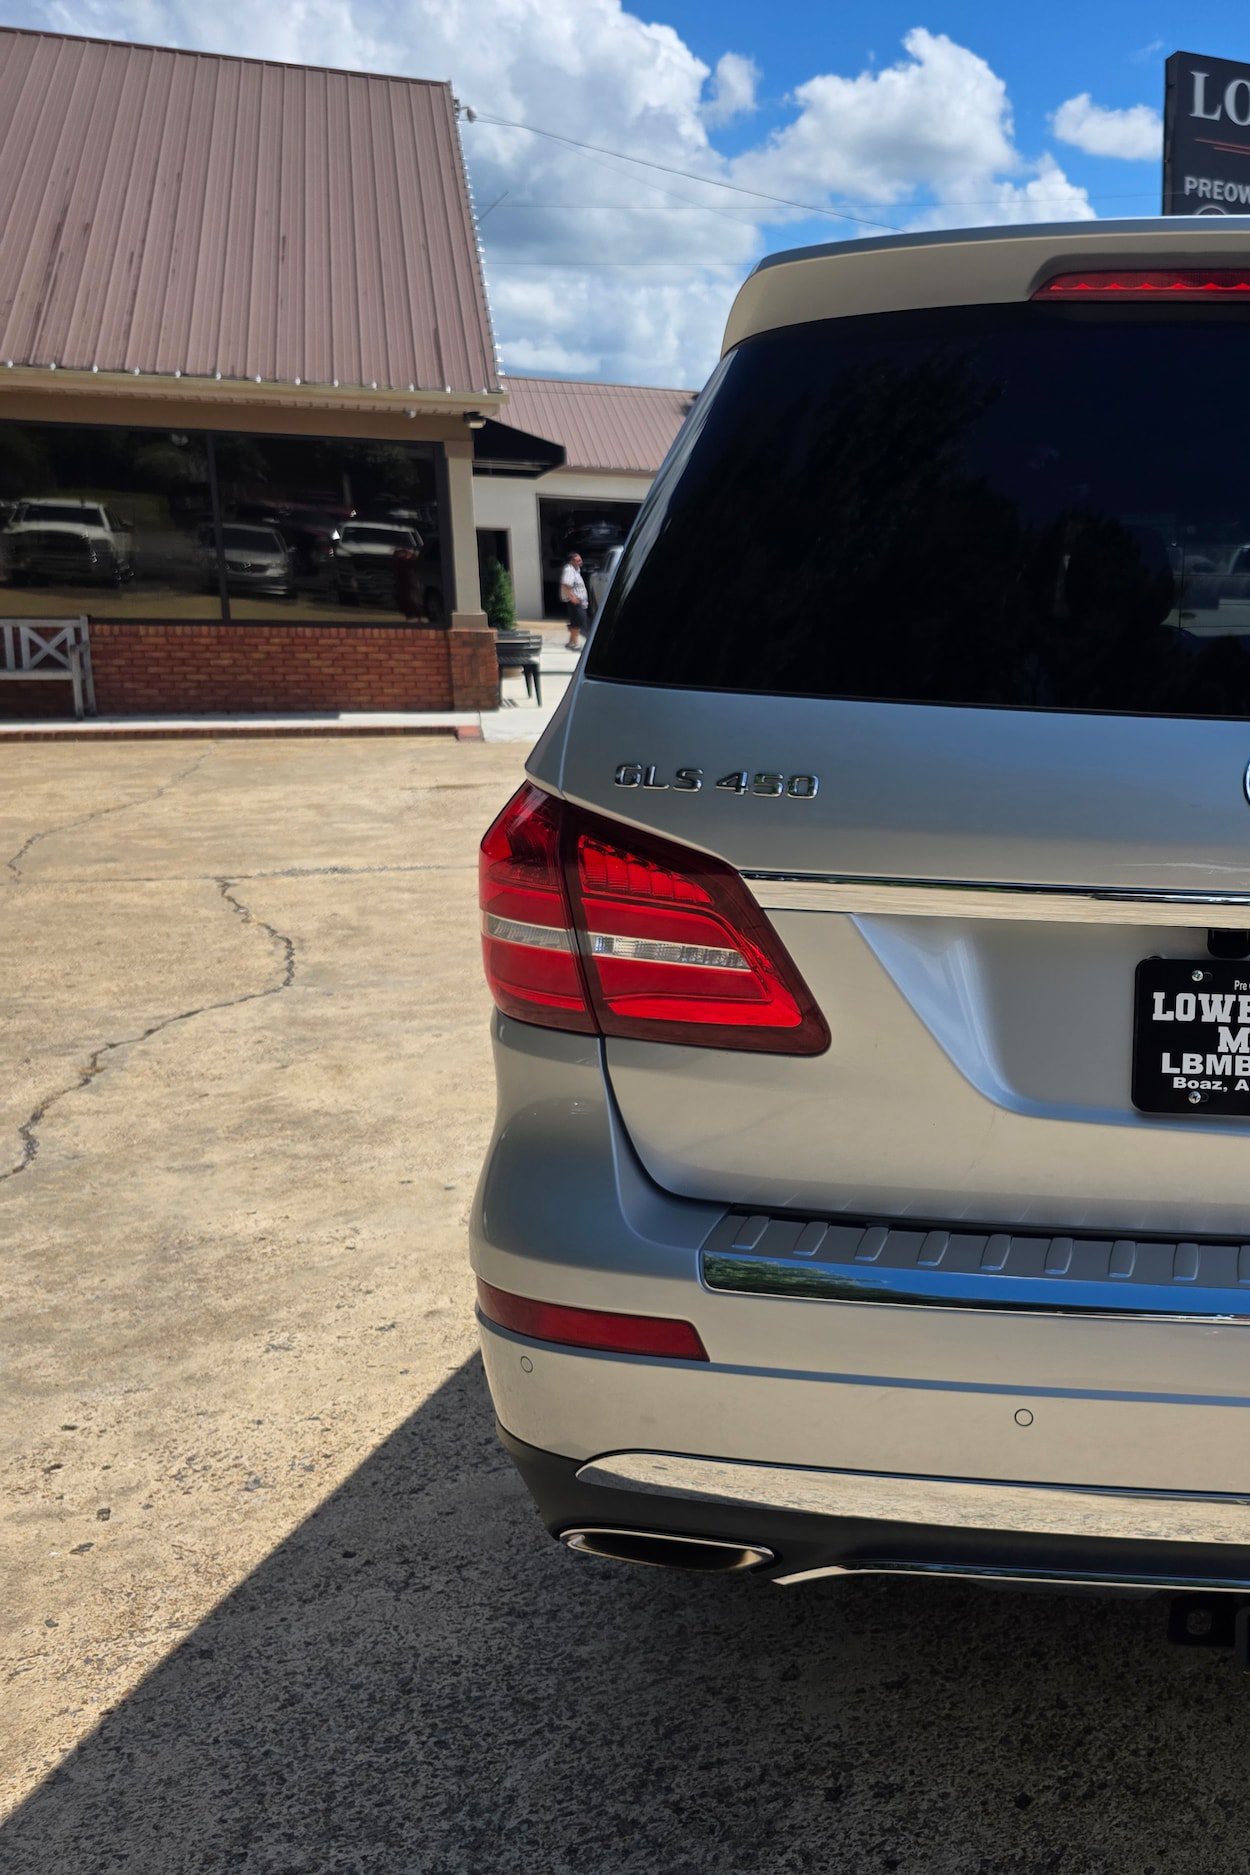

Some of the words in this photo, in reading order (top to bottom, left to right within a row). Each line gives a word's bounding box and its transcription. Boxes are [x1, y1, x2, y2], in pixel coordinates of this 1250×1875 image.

[614, 764, 704, 793] GLS
[715, 771, 820, 800] 450
[1234, 980, 1247, 991] Pre
[1172, 1077, 1228, 1093] Boaz,
